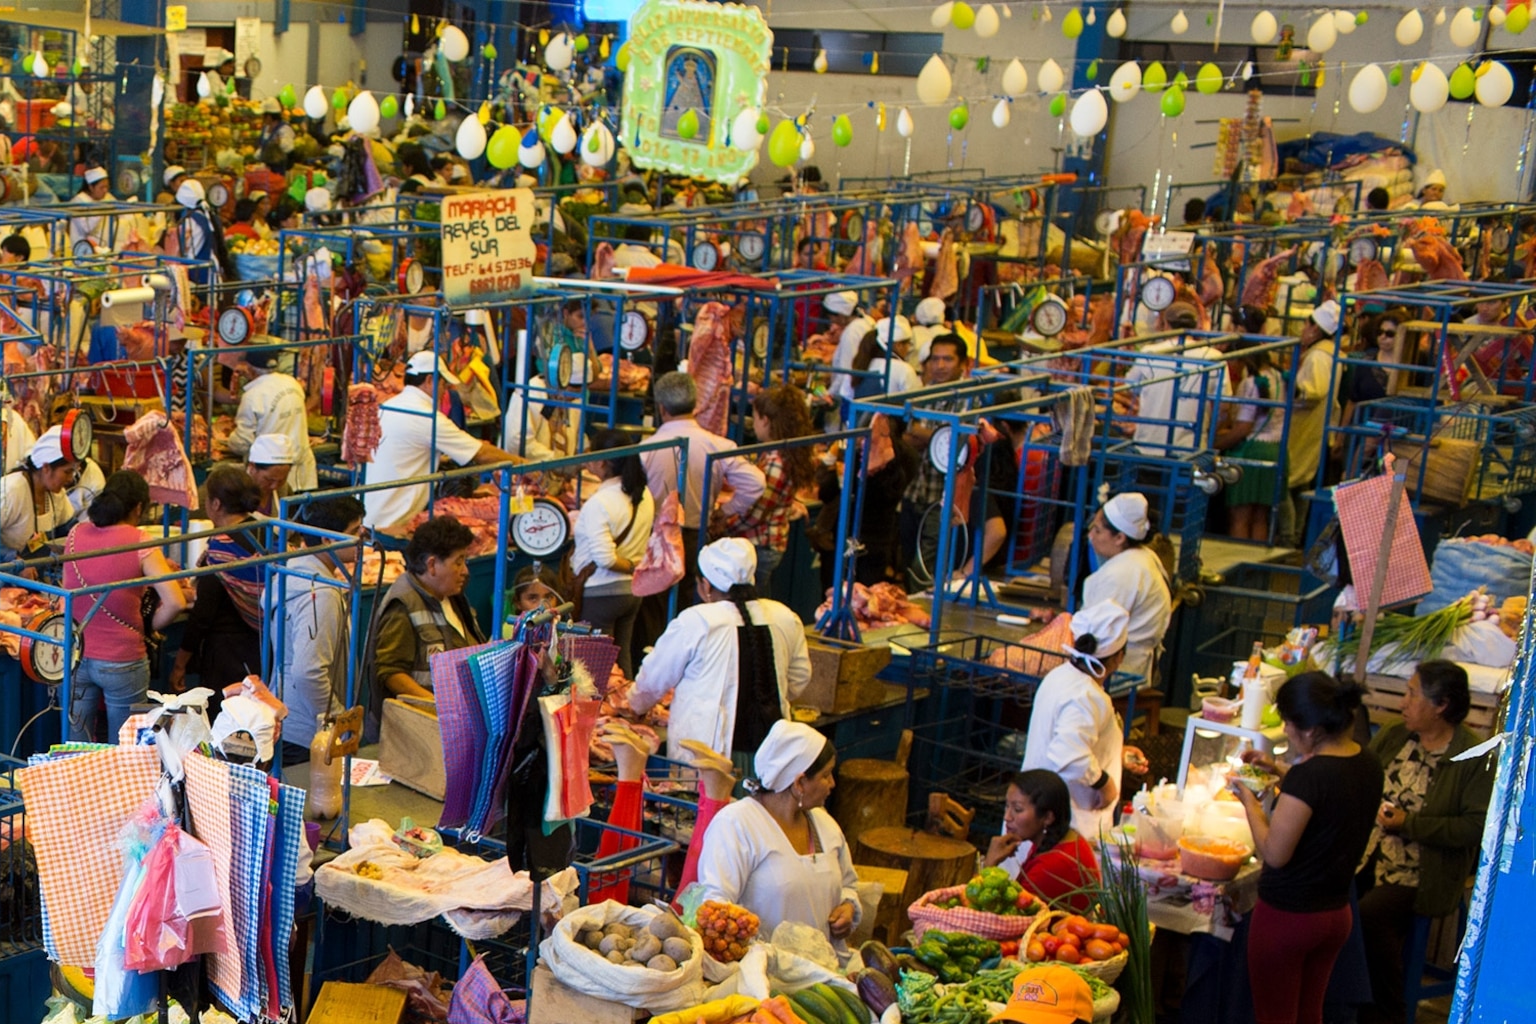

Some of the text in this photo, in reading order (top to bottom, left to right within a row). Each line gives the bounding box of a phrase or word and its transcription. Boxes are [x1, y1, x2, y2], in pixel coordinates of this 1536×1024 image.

[448, 196, 516, 219] MARIACHI
[443, 216, 521, 243] REYES DEL
[470, 238, 499, 259] SUR
